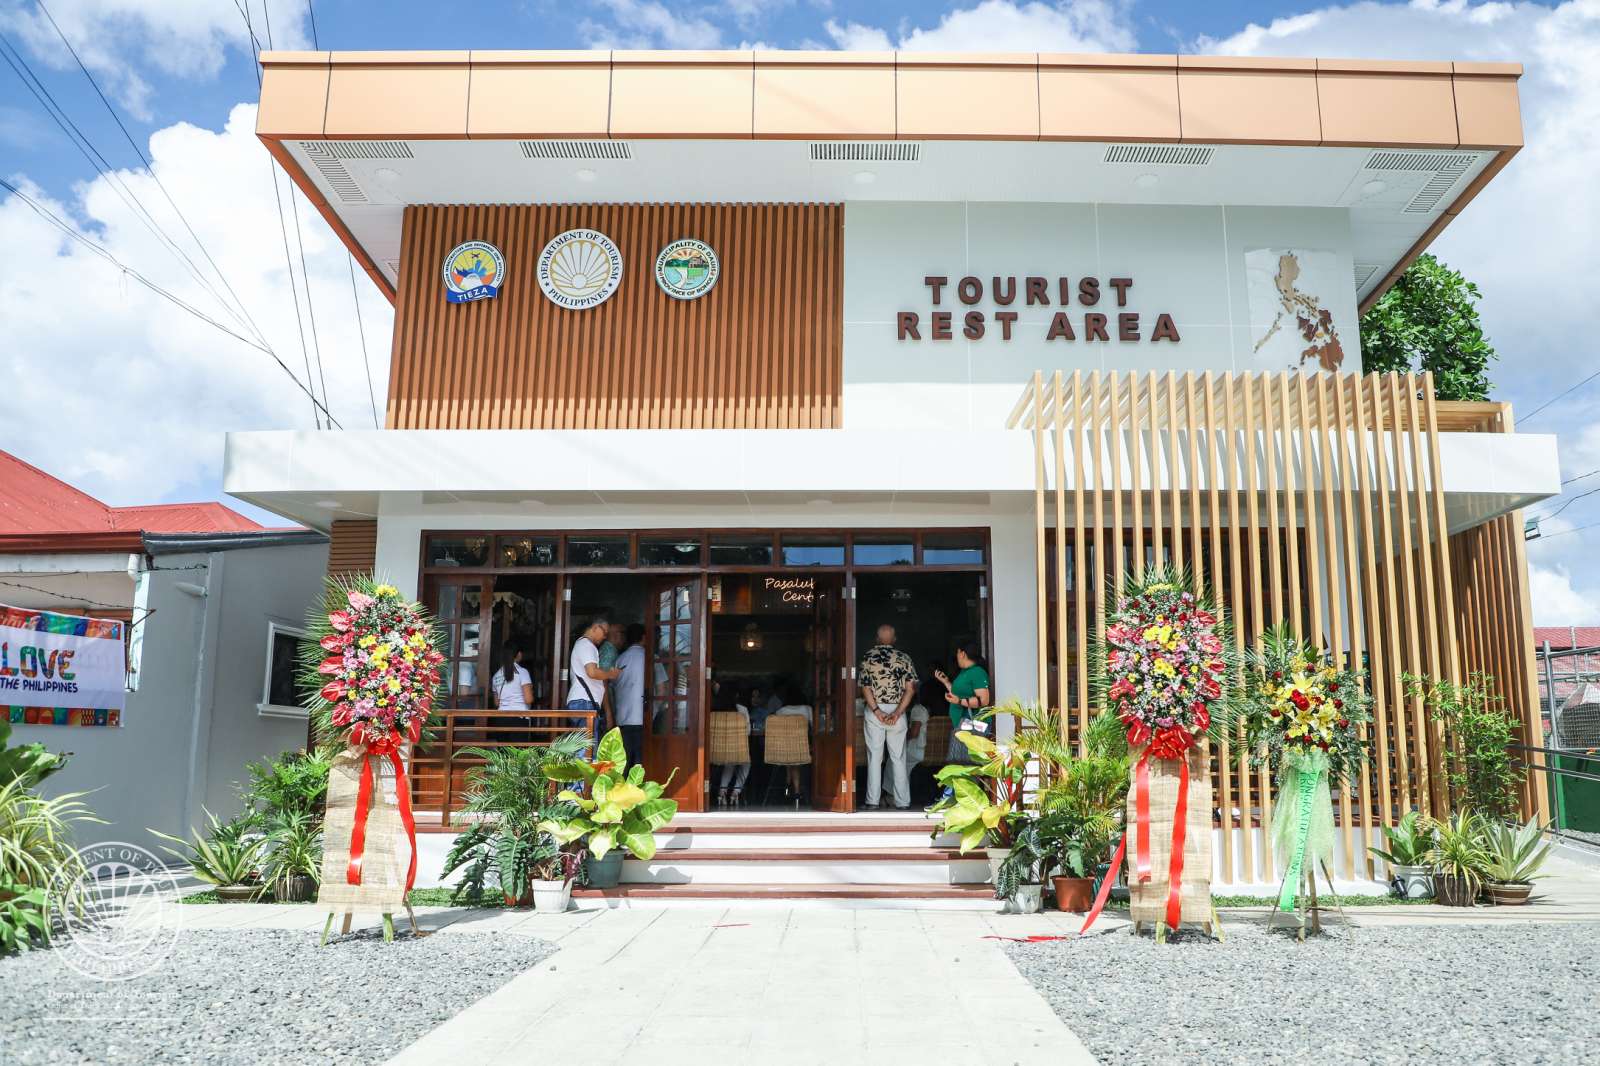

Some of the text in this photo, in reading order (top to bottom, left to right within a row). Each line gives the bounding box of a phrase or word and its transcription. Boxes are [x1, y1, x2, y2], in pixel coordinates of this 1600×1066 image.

[541, 231, 584, 280] DEPARTMENT
[585, 232, 600, 240] OF
[600, 237, 620, 280] TOURISM
[657, 241, 697, 272] MUNICIPALITY
[697, 244, 708, 252] OF
[457, 287, 489, 301] TIEZA
[548, 287, 609, 306] PHILIPPINES
[924, 276, 1133, 306] TOURIST
[897, 311, 1180, 342] REST AREA
[782, 590, 825, 603] Centr
[0, 641, 76, 681] LOVE
[0, 677, 79, 693] THE PHILIPPINES
